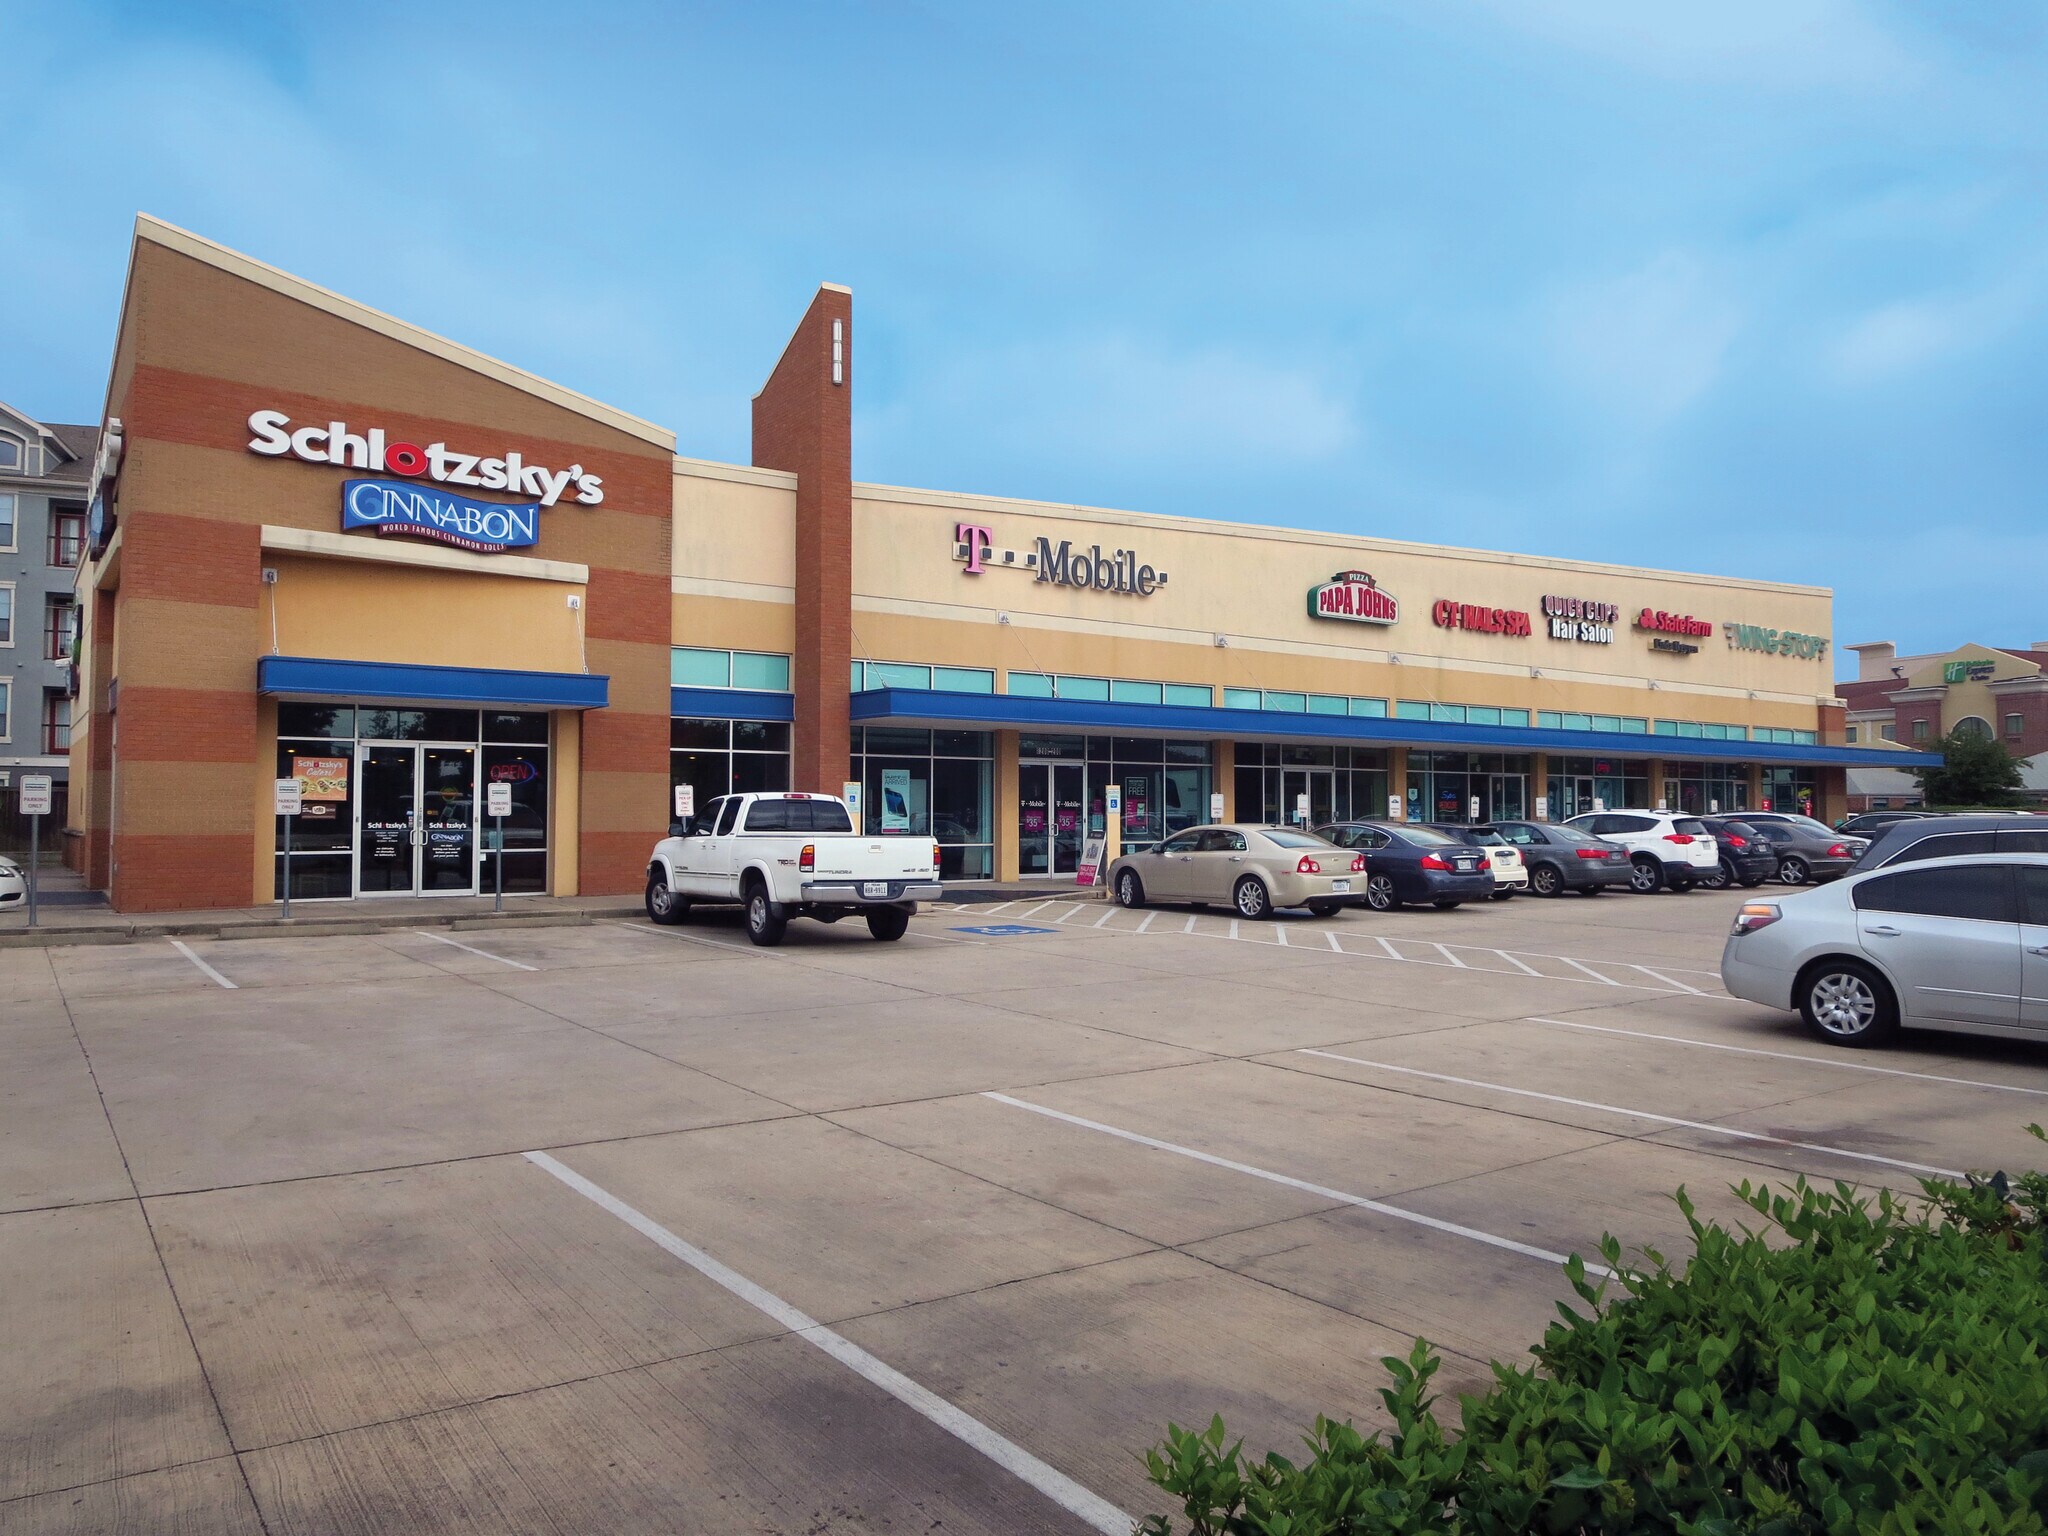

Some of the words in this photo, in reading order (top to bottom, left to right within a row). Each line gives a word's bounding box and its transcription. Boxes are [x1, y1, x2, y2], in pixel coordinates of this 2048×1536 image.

[248, 410, 604, 507] Schlotzsky's
[349, 483, 536, 541] CINNABON
[412, 525, 441, 538] FAMOUS
[443, 533, 481, 549] CINNAMON
[483, 543, 505, 551] ROLLS
[1349, 573, 1369, 583] PIZZA
[1320, 586, 1354, 615] PAPA
[1542, 594, 1584, 619] QUICK
[1583, 601, 1619, 622] CLIPS
[1432, 600, 1460, 629] CT
[1460, 604, 1505, 633] NAILS
[1504, 610, 1532, 637] SPA
[1550, 618, 1579, 640] Hair
[1580, 621, 1614, 644] Salon
[298, 760, 343, 768] Schlotzsky's
[490, 764, 528, 781] OPEN
[1128, 787, 1145, 796] FREE
[367, 822, 407, 830] Schlotzsky's
[429, 822, 467, 830] Schlotzsky's
